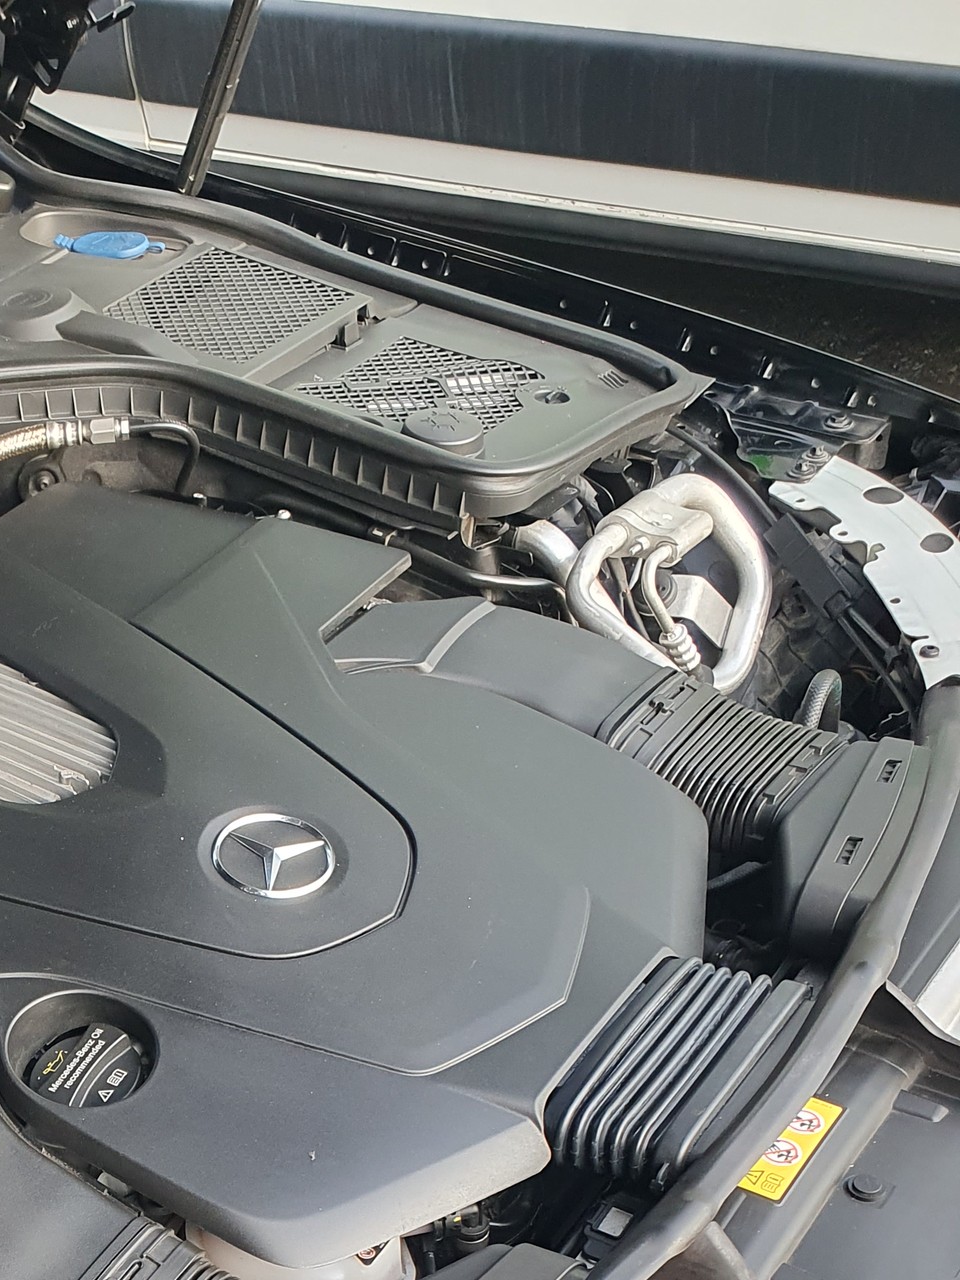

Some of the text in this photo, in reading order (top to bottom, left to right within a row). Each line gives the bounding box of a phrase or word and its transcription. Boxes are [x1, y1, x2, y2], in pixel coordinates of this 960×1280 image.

[48, 1028, 104, 1093] Mercedes-Benz Oil
[64, 1039, 106, 1089] recommended
